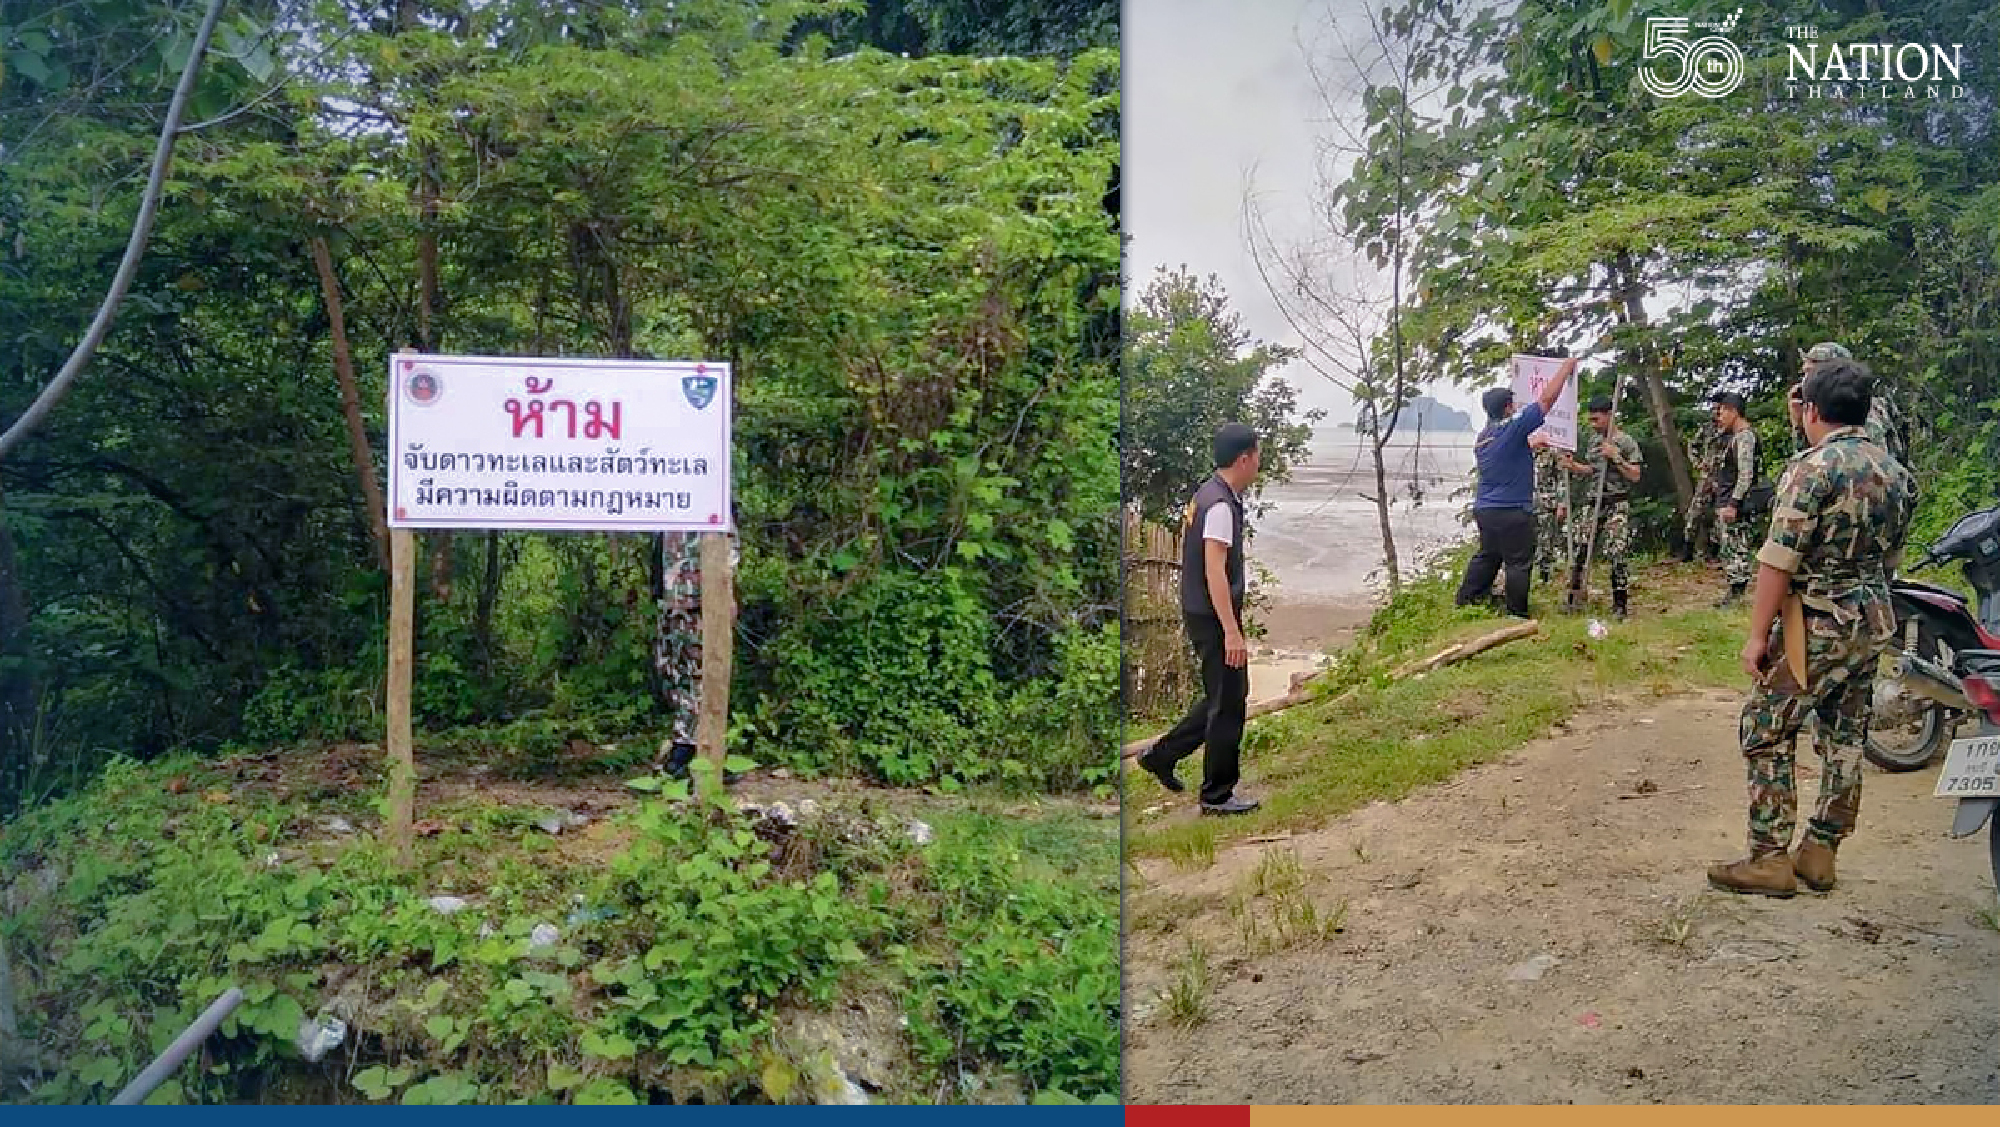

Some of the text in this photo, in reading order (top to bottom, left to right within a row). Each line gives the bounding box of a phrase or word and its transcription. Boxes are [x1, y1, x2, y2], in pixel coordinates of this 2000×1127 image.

[504, 376, 621, 440] ห้าม
[404, 442, 708, 475] จับดาวทะเลและสัตว์ทะเล
[1947, 776, 1996, 791] 7305
